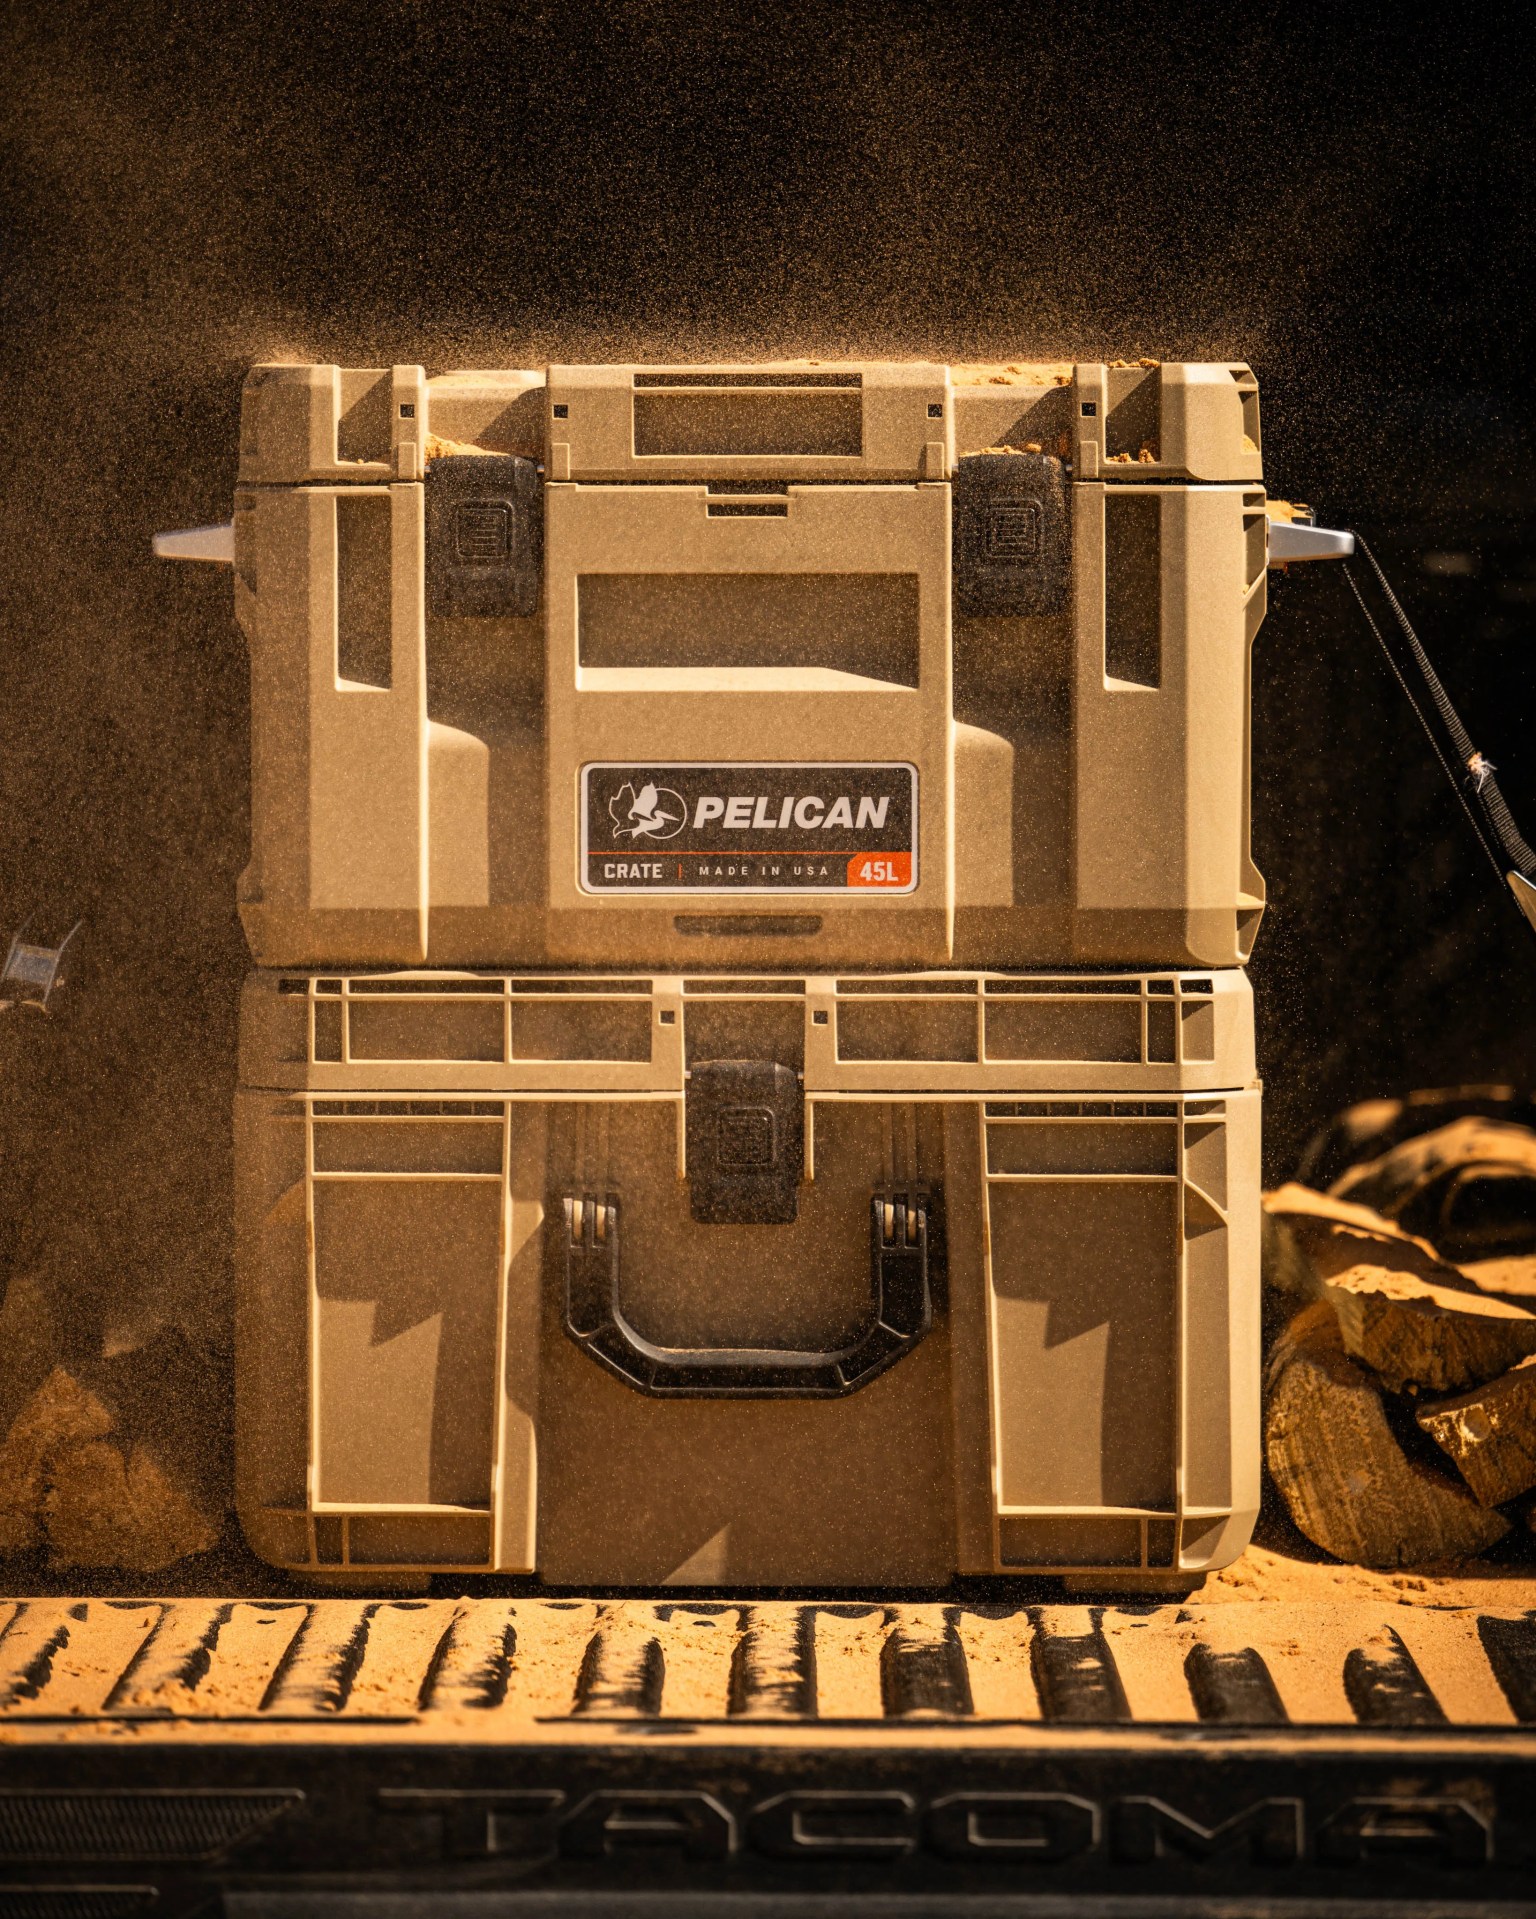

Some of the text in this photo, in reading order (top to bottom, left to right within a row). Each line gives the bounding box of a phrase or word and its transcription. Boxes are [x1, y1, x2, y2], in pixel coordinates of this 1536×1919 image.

[692, 796, 890, 830] PELICAN
[604, 863, 663, 879] CRATE
[699, 866, 829, 876] MADE IN USA
[859, 861, 899, 882] 45L
[376, 1787, 1496, 1863] TACOMA
